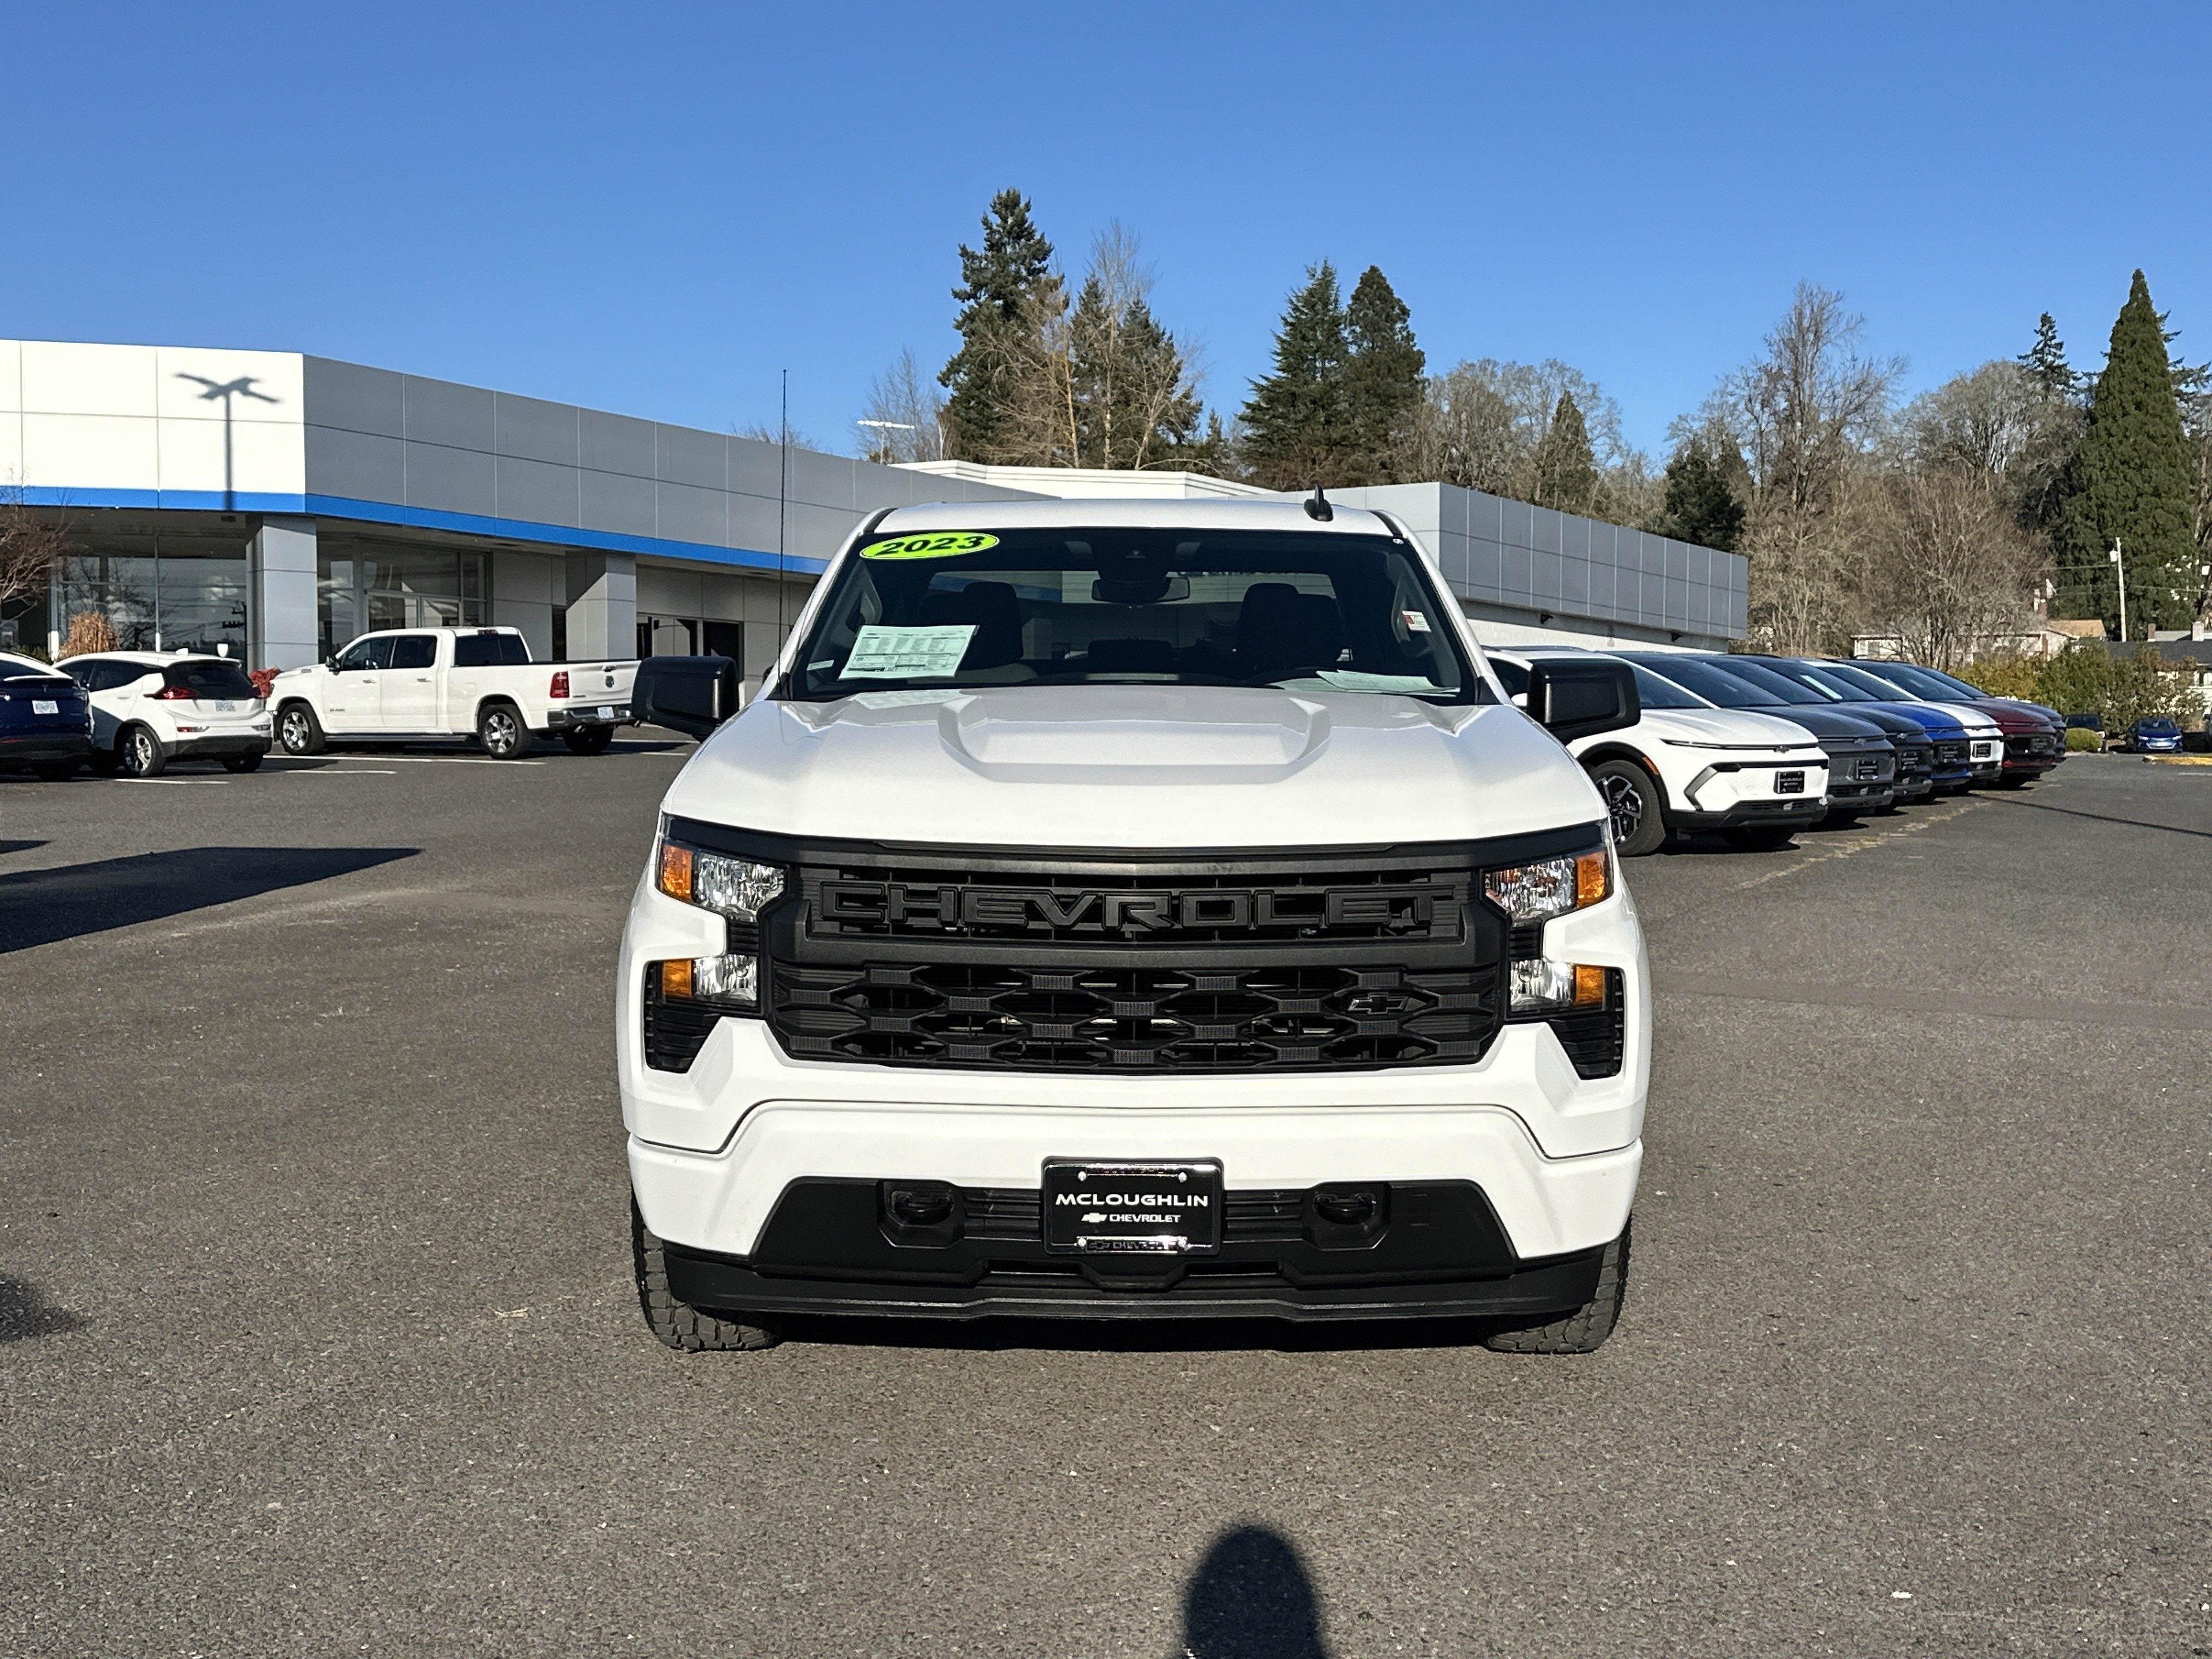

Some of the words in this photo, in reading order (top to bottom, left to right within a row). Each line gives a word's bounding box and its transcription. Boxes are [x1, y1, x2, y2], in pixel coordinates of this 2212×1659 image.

[874, 535, 985, 556] 2023
[821, 880, 1456, 930] CHEVROLET
[1055, 1193, 1208, 1207] MCLOUGHLIN
[1109, 1214, 1182, 1222] CHEVROLET
